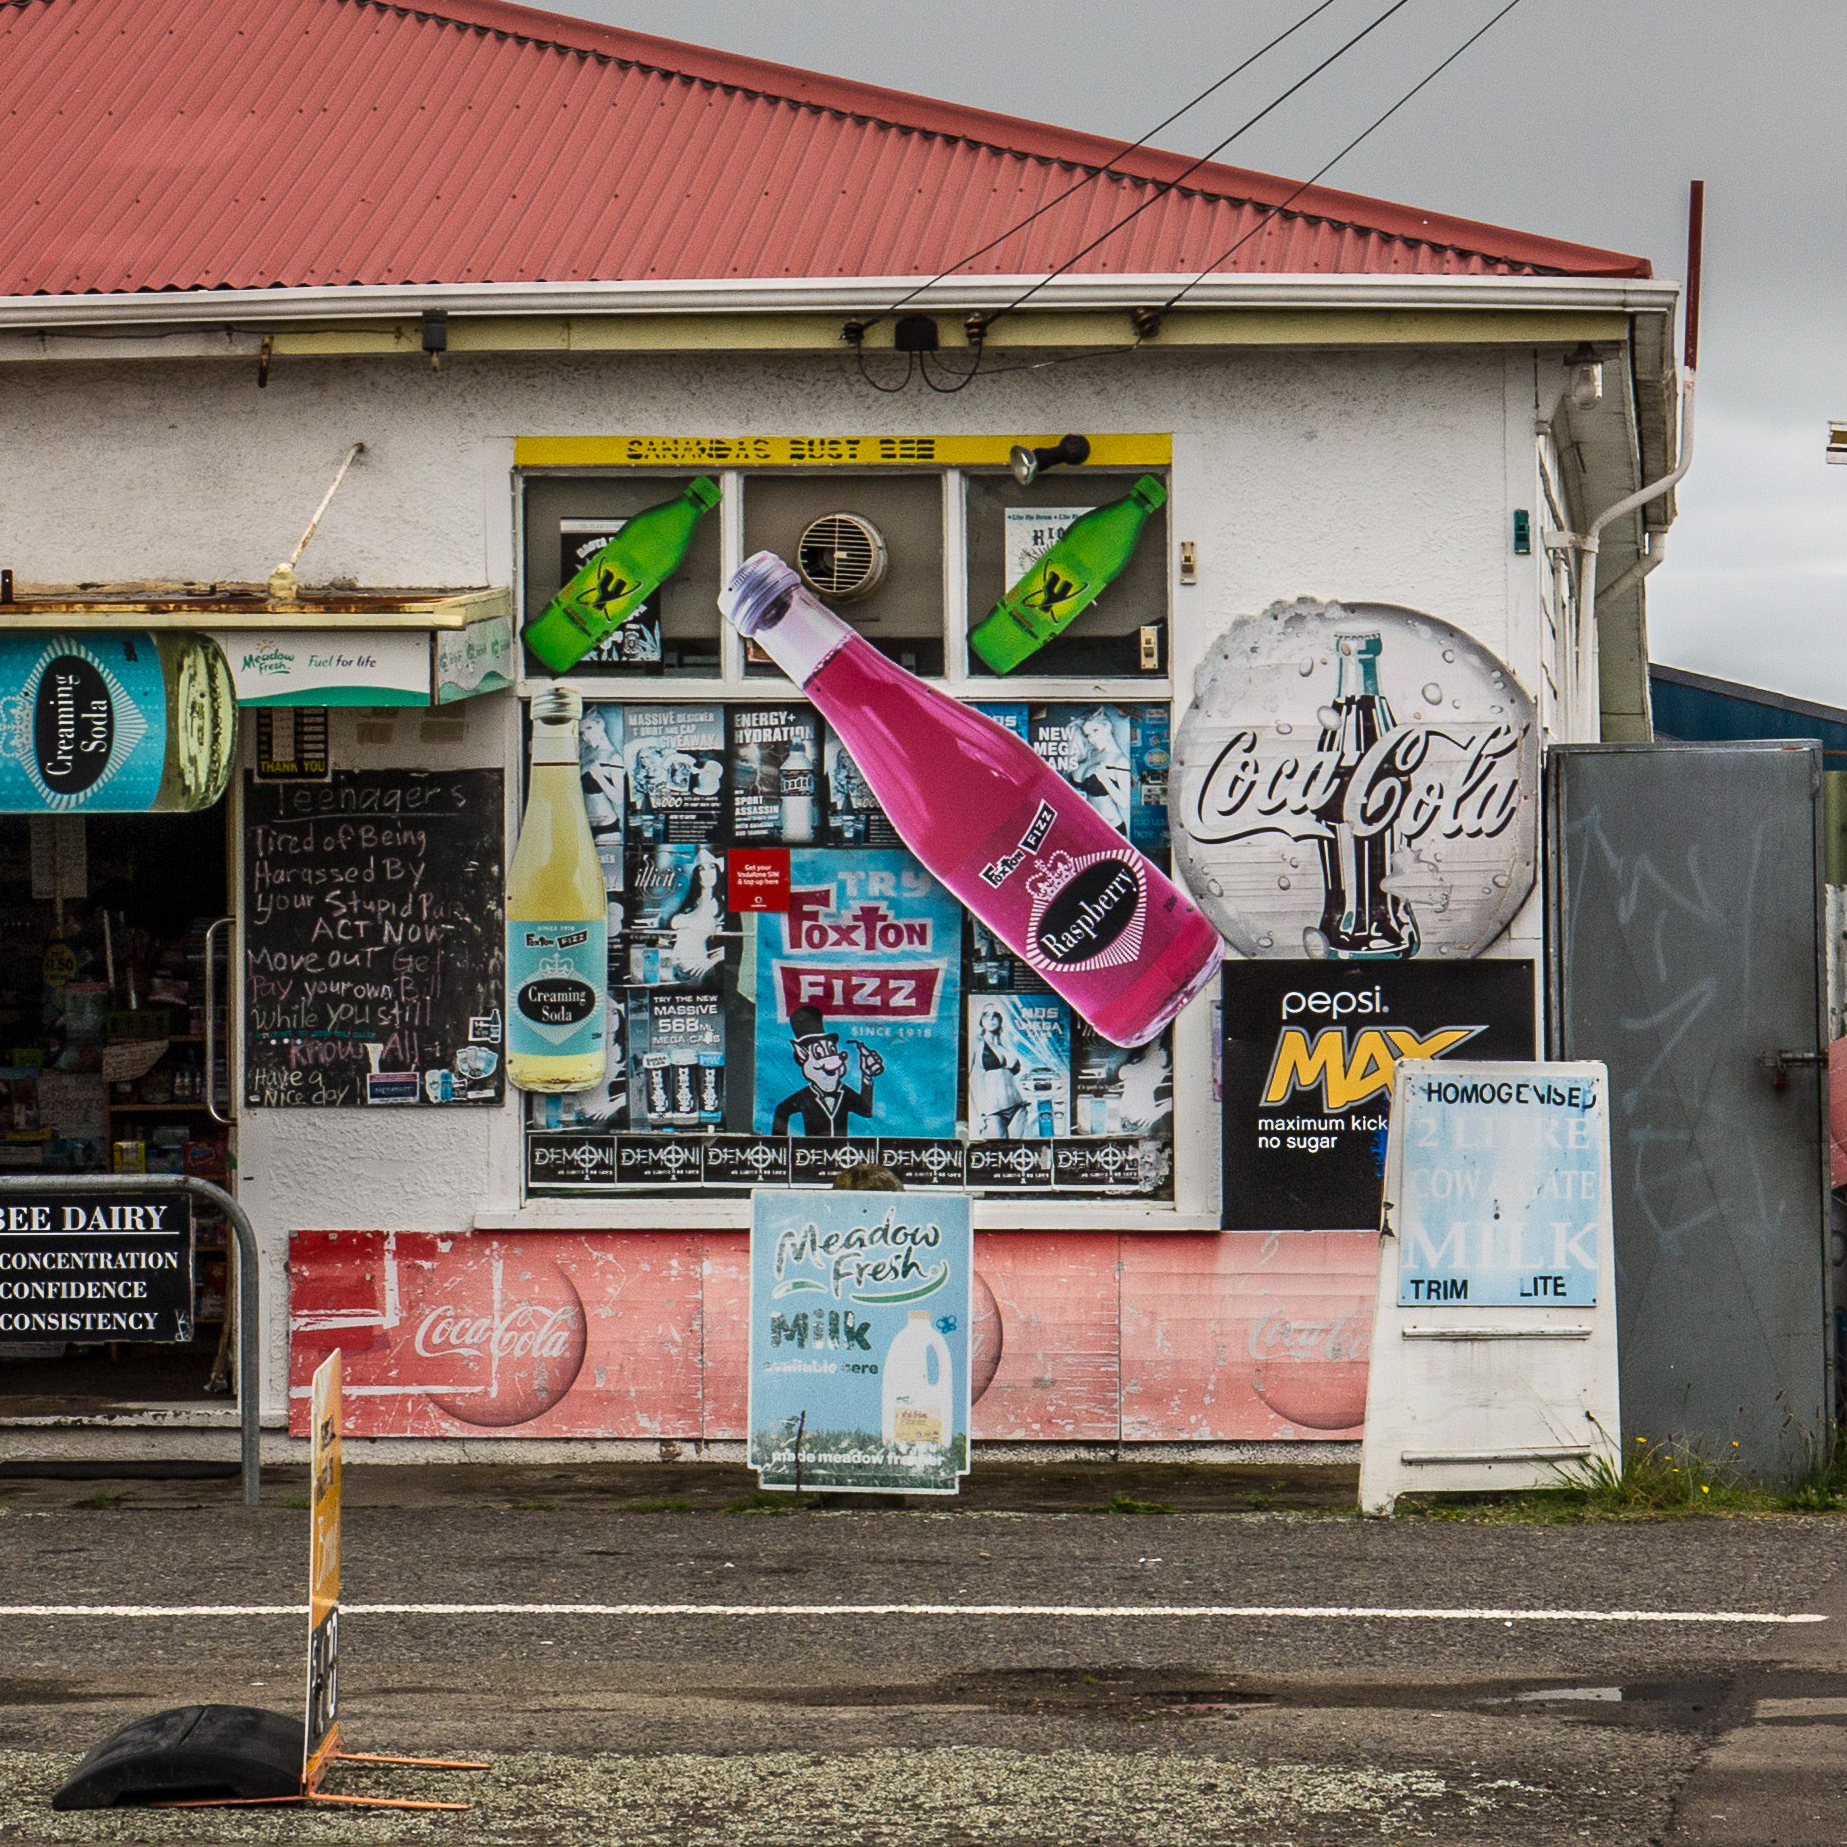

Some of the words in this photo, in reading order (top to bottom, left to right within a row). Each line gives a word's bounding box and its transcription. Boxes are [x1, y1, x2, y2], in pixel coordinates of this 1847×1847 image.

[879, 438, 936, 460] BEE
[241, 650, 295, 672] Meadow
[307, 655, 334, 668] Fuel
[336, 654, 354, 667] for
[356, 655, 377, 668] life
[46, 674, 81, 776] Creaming
[80, 699, 108, 752] Soda
[628, 712, 675, 726] MASSIVE
[676, 713, 715, 723] DESIGNER
[679, 725, 697, 735] CAP
[734, 711, 796, 728] ENERGY+
[1038, 727, 1074, 741] NEW
[1034, 741, 1081, 756] MEGA
[260, 761, 298, 773] THANK
[304, 760, 325, 772] YOU
[1189, 724, 1531, 844] Coca-Cola
[735, 796, 764, 805] SPORT
[735, 805, 780, 816] ASSASSIN
[251, 824, 314, 857] Tired
[324, 826, 354, 851] of
[254, 855, 375, 892] Harassed
[757, 864, 772, 872] your
[839, 871, 934, 896] TRY
[788, 888, 929, 950] FOXTON
[1041, 869, 1138, 959] Raspberry
[311, 916, 373, 944] ACT
[247, 949, 326, 974] Move
[528, 987, 587, 1006] Creaming
[696, 995, 718, 1003] NEW
[801, 975, 918, 1007] FIZZ
[541, 1006, 573, 1022] Soda
[654, 1005, 718, 1016] MASSIVE
[653, 1035, 686, 1045] MEGA
[851, 1027, 892, 1038] SINCE
[898, 1027, 933, 1038] 1918
[1260, 1025, 1491, 1114] MAX
[1258, 1117, 1345, 1132] maximum
[1351, 1114, 1388, 1132] kick
[1417, 1118, 1439, 1148] 2
[1258, 1135, 1282, 1149] no
[1286, 1135, 1338, 1153] sugar
[62, 1206, 169, 1231] DAIRY
[773, 1206, 943, 1277] Meadow
[1400, 1220, 1599, 1271] MILK
[832, 1245, 929, 1300] Fresh
[1410, 1279, 1469, 1301] TRIM
[1520, 1276, 1568, 1298] LITE
[416, 1304, 578, 1360] Coca-Cola
[770, 1308, 872, 1351] Milk
[763, 1360, 838, 1374] available
[840, 1360, 879, 1375] here
[771, 1452, 815, 1465] made
[818, 1451, 884, 1465] meadow
